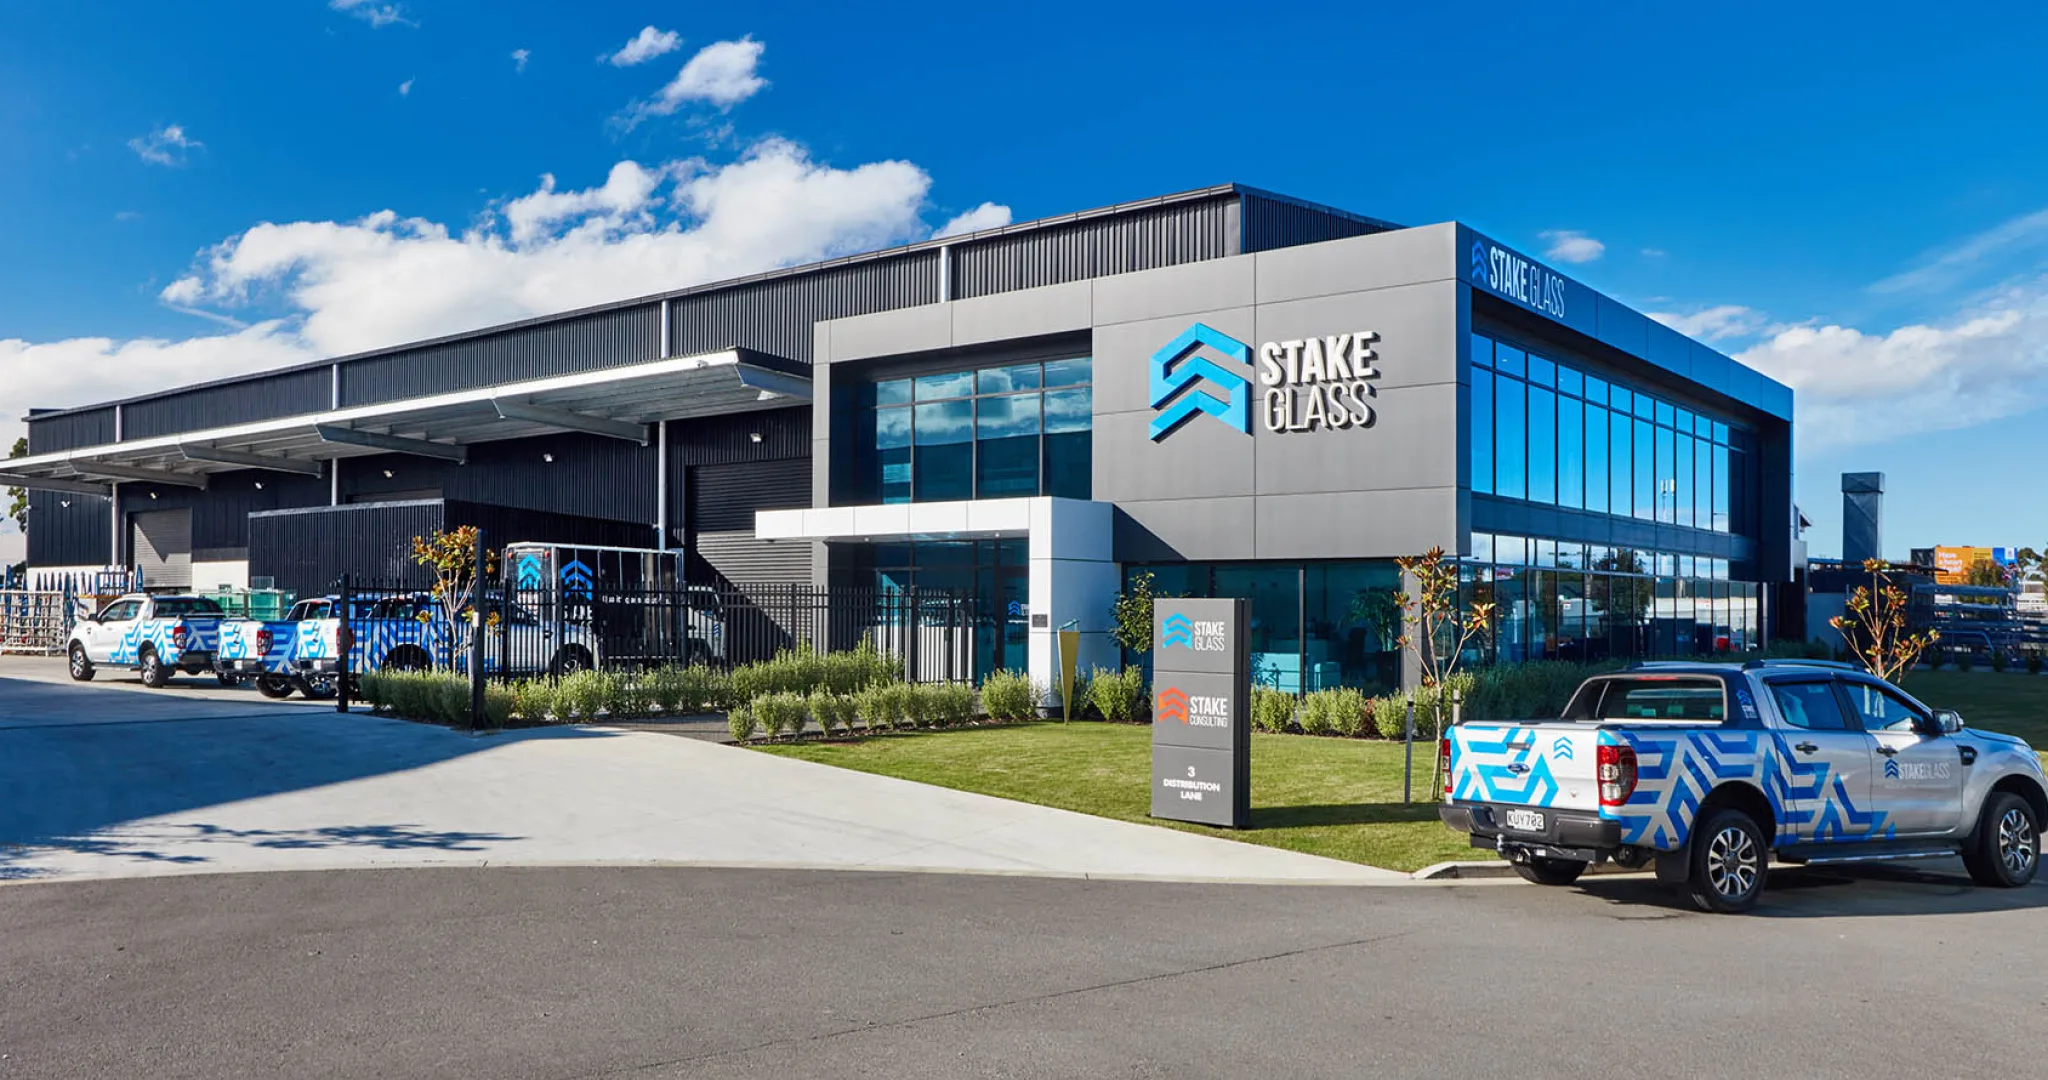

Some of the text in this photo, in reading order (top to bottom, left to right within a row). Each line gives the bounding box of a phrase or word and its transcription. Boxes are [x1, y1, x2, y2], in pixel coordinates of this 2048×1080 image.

[1490, 245, 1565, 318] STAKE GLASS
[1260, 331, 1376, 386] STAKE
[1264, 380, 1372, 431] GLASS
[1194, 621, 1225, 637] STAKE
[1194, 636, 1225, 651] GLASS
[1189, 696, 1228, 716] STAKE
[1189, 714, 1228, 728] CONSULTING
[1187, 766, 1196, 778] 3
[1899, 762, 1926, 779] STAKE
[1163, 778, 1221, 792] DISTRIBUTION
[1180, 790, 1203, 802] LANE
